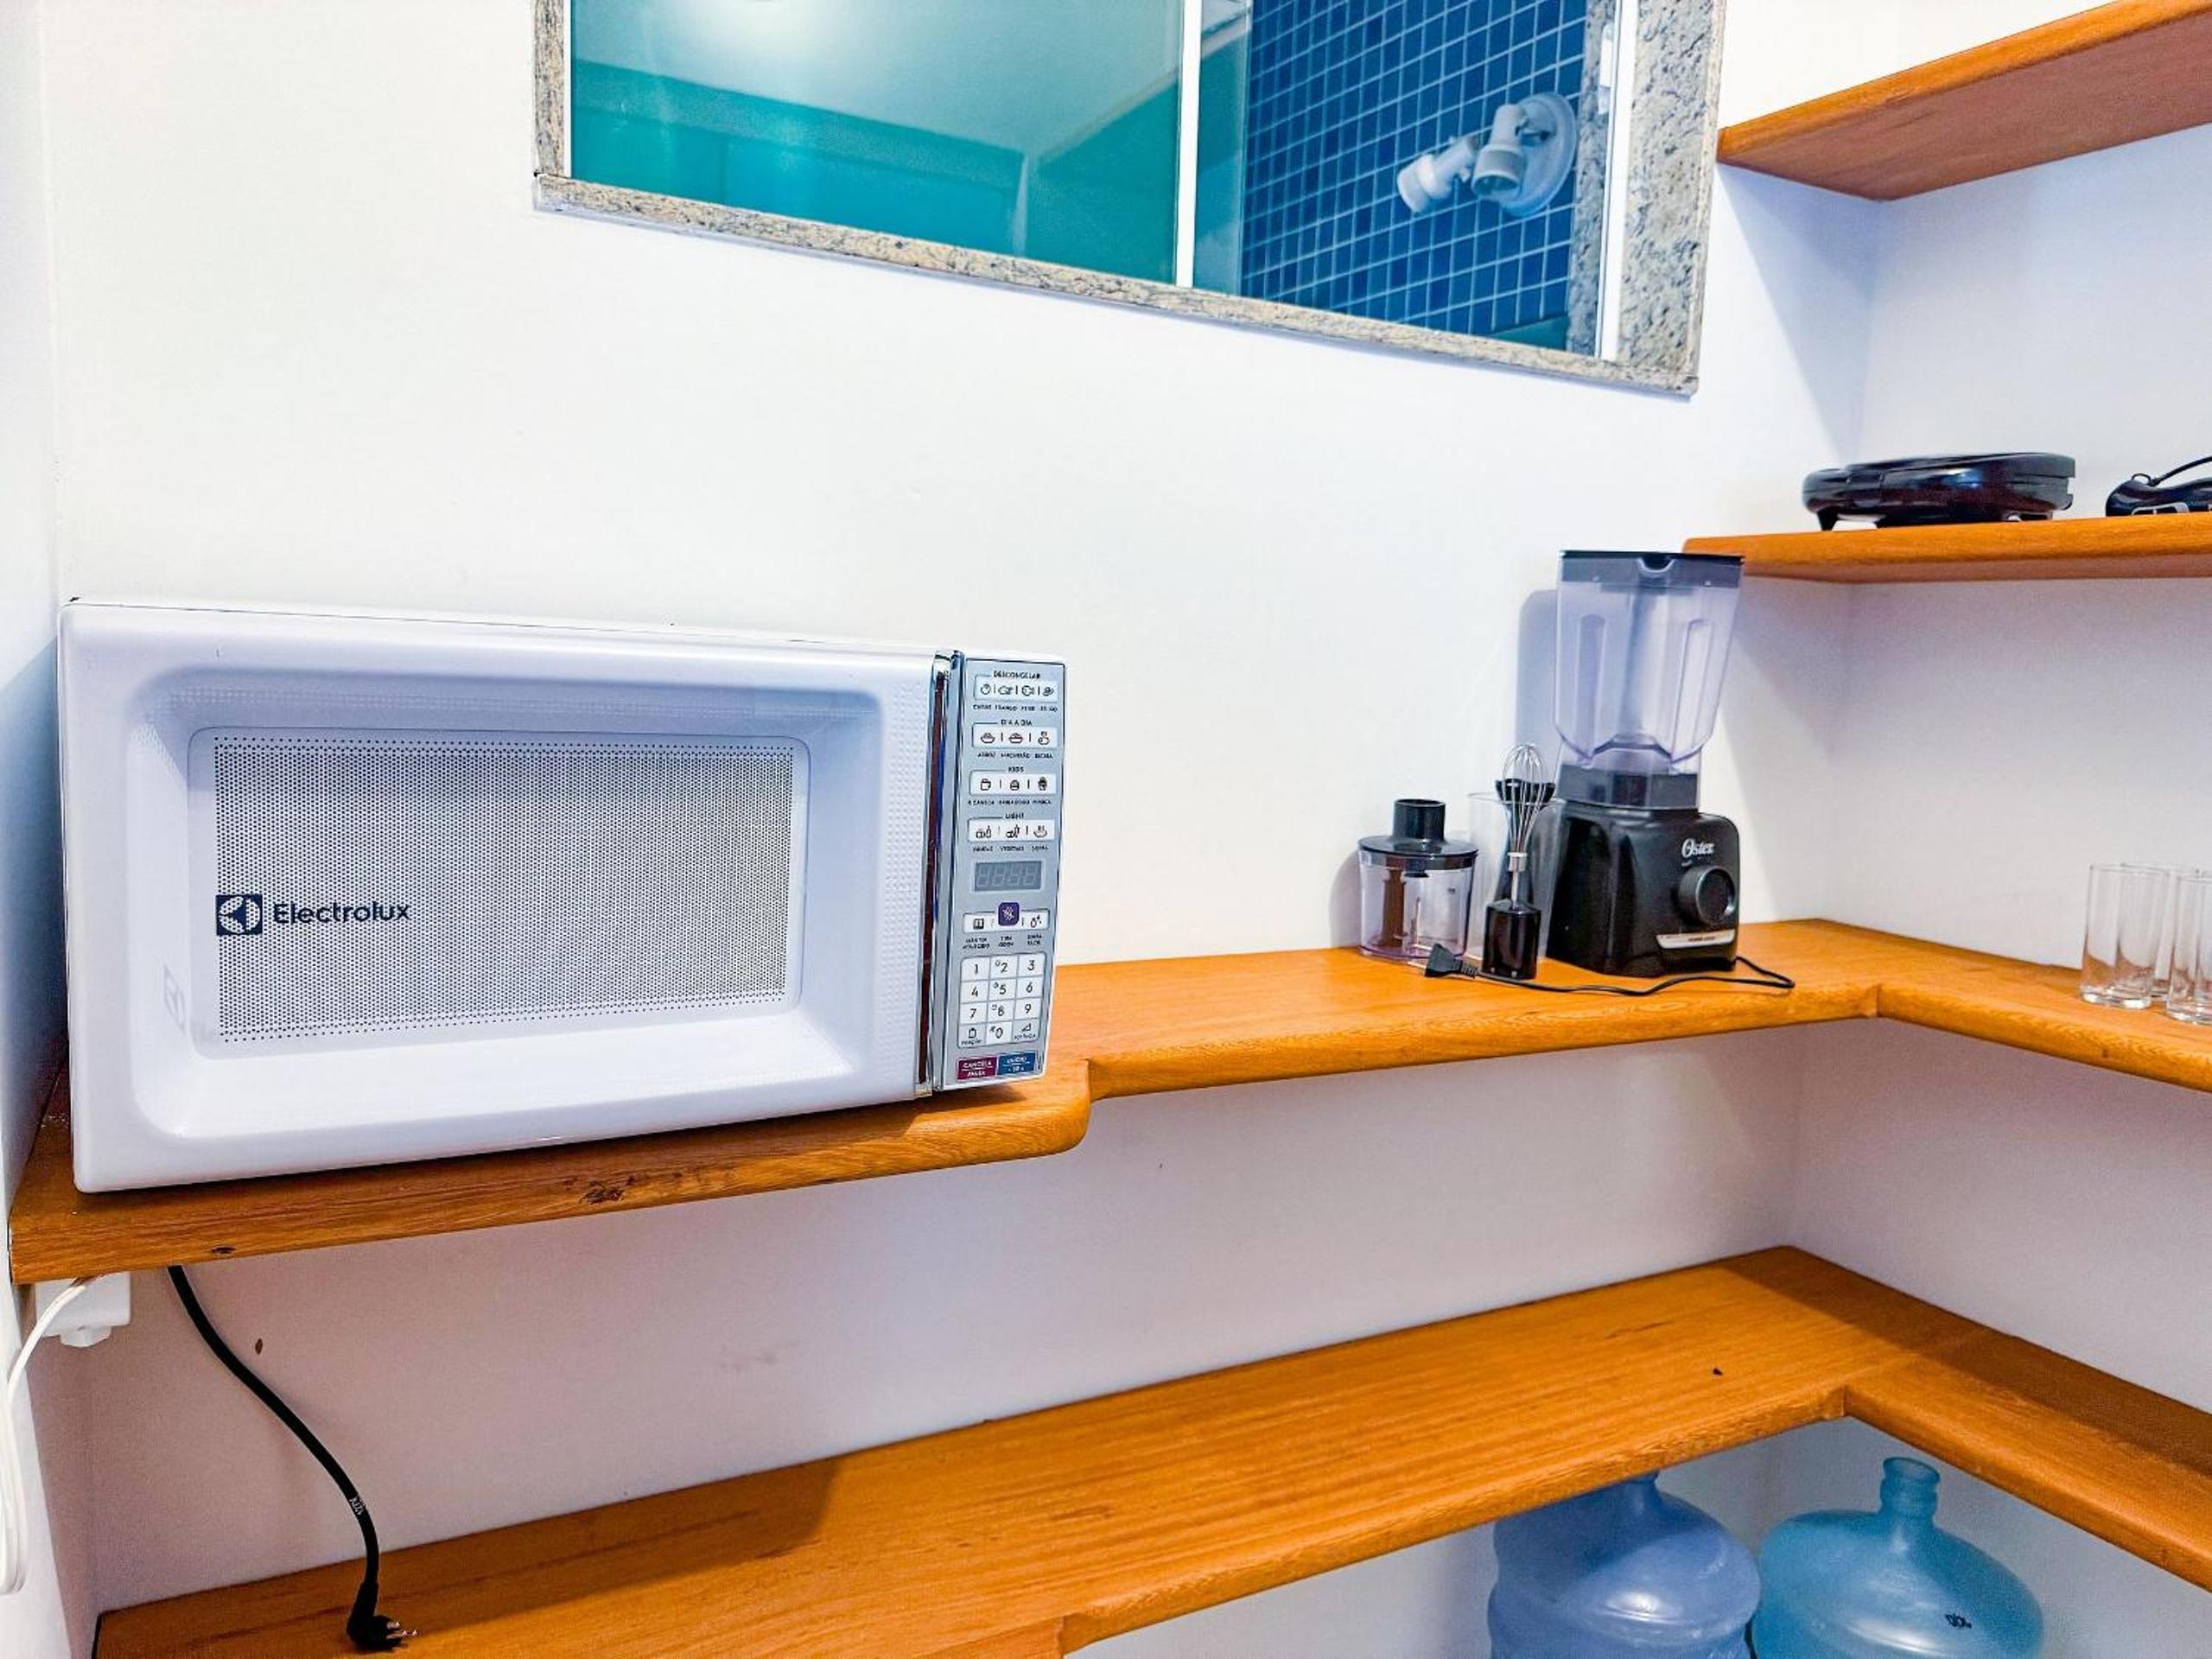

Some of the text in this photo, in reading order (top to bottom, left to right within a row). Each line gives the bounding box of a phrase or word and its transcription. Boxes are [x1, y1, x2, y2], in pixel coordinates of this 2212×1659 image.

[272, 901, 411, 925] Electrolux
[974, 963, 979, 975] 1
[1001, 962, 1008, 973] 2
[1027, 959, 1035, 971] 3
[971, 985, 979, 997] 4
[999, 984, 1007, 995] 5
[1026, 982, 1033, 993] 6
[969, 1007, 977, 1019] 7
[1024, 1003, 1032, 1014] 9
[995, 1027, 1003, 1039] 0
